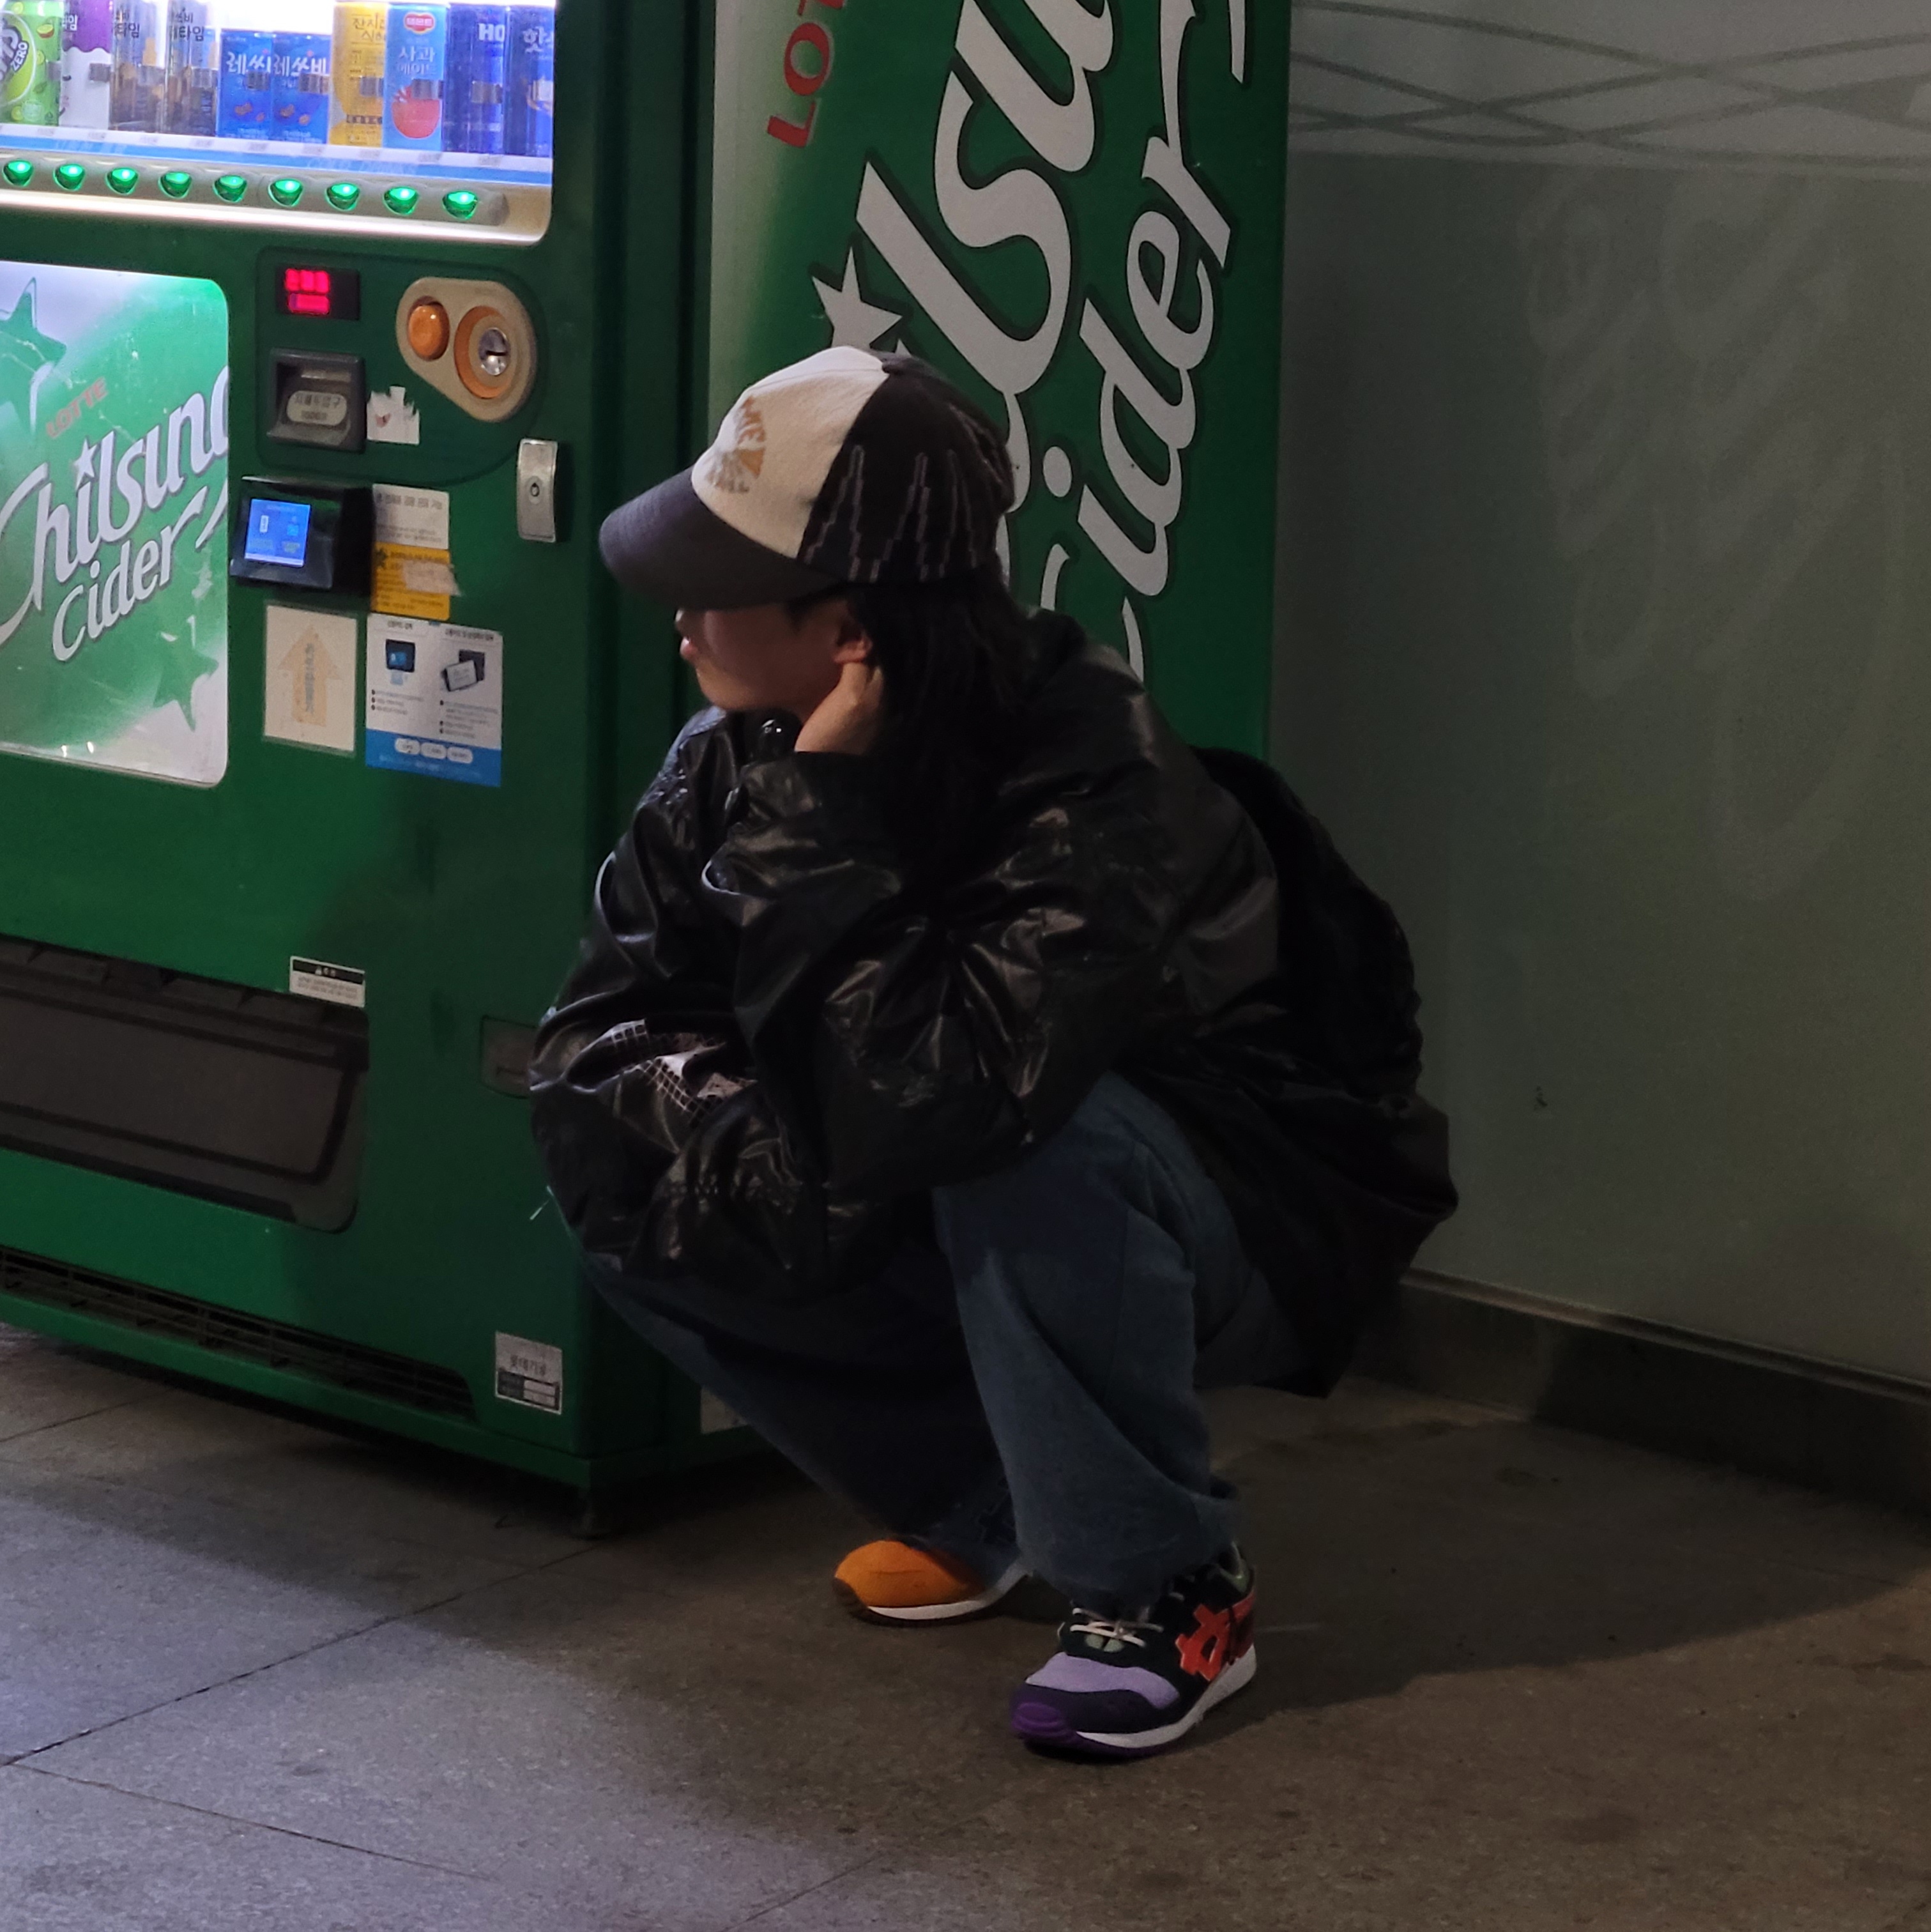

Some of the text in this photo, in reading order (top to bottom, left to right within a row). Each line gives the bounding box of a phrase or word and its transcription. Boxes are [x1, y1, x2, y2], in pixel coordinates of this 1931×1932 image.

[10, 41, 29, 72] ZERO
[273, 54, 327, 77] 레쓰비
[397, 47, 436, 63] 사과
[46, 376, 108, 439] LOTTE
